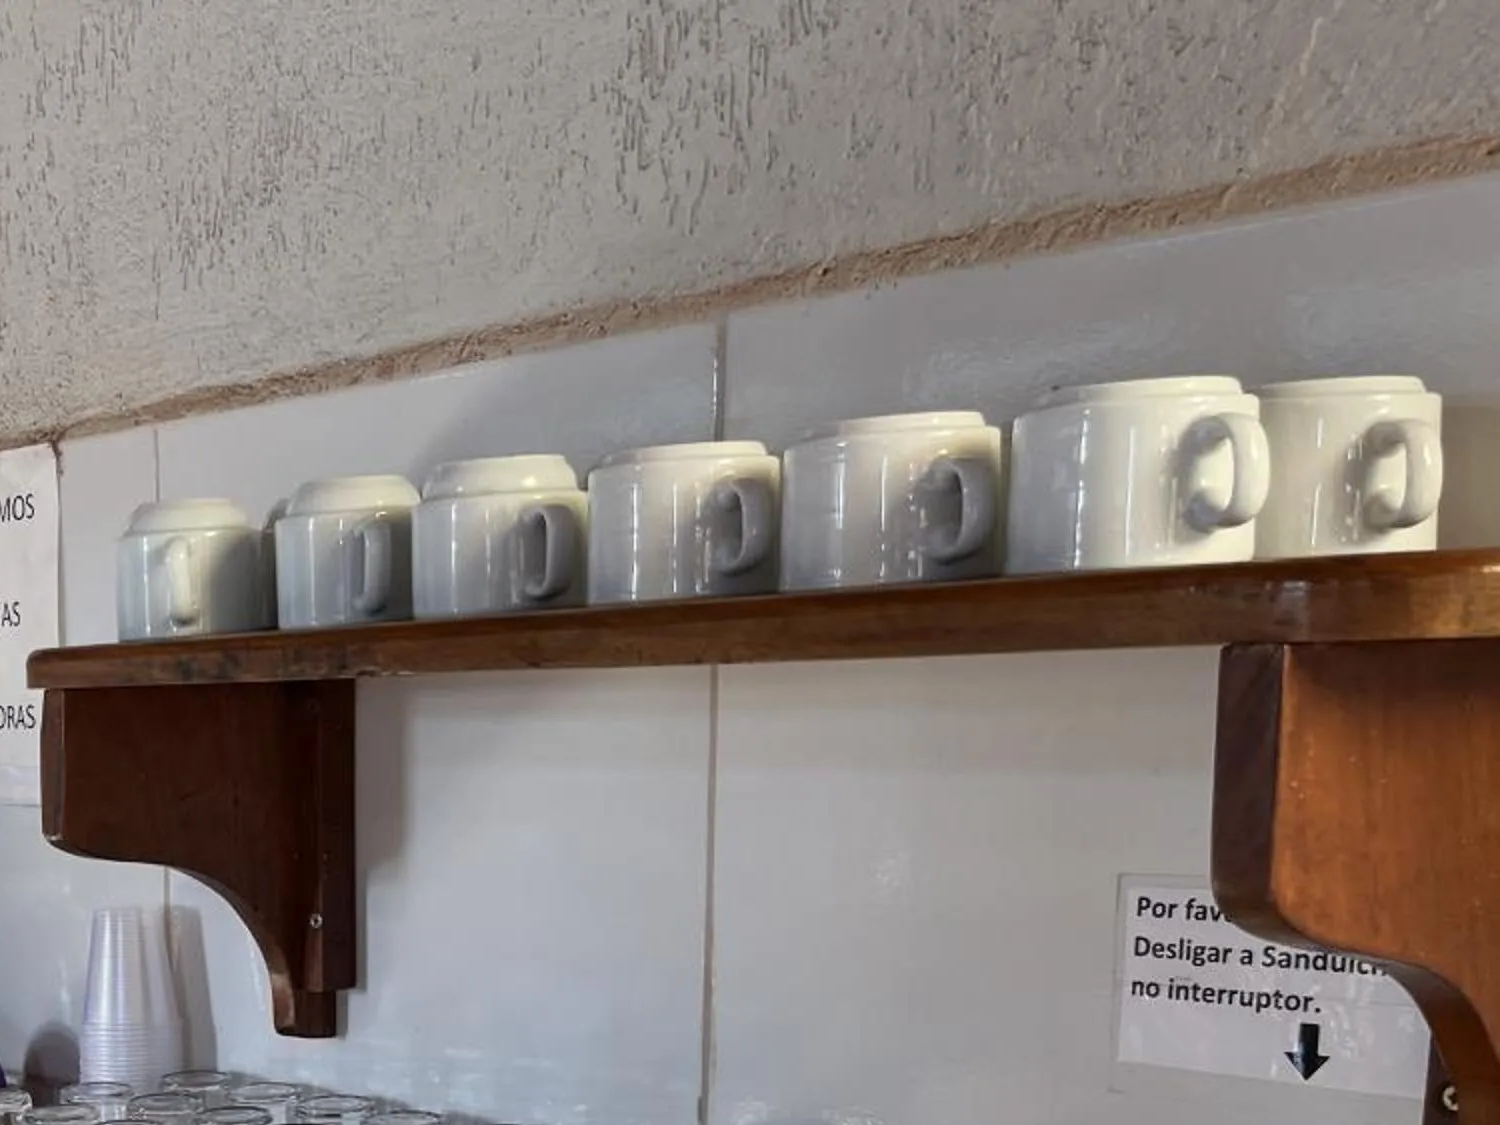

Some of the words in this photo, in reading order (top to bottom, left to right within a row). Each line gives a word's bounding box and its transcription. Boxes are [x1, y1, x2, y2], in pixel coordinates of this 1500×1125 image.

[1, 601, 21, 627] AS
[1136, 896, 1179, 919] Por
[1185, 897, 1232, 923] fav
[1134, 936, 1233, 966] Desligar
[1239, 948, 1253, 966] a
[1131, 979, 1160, 999] no
[1167, 978, 1322, 1014] interruptor.
